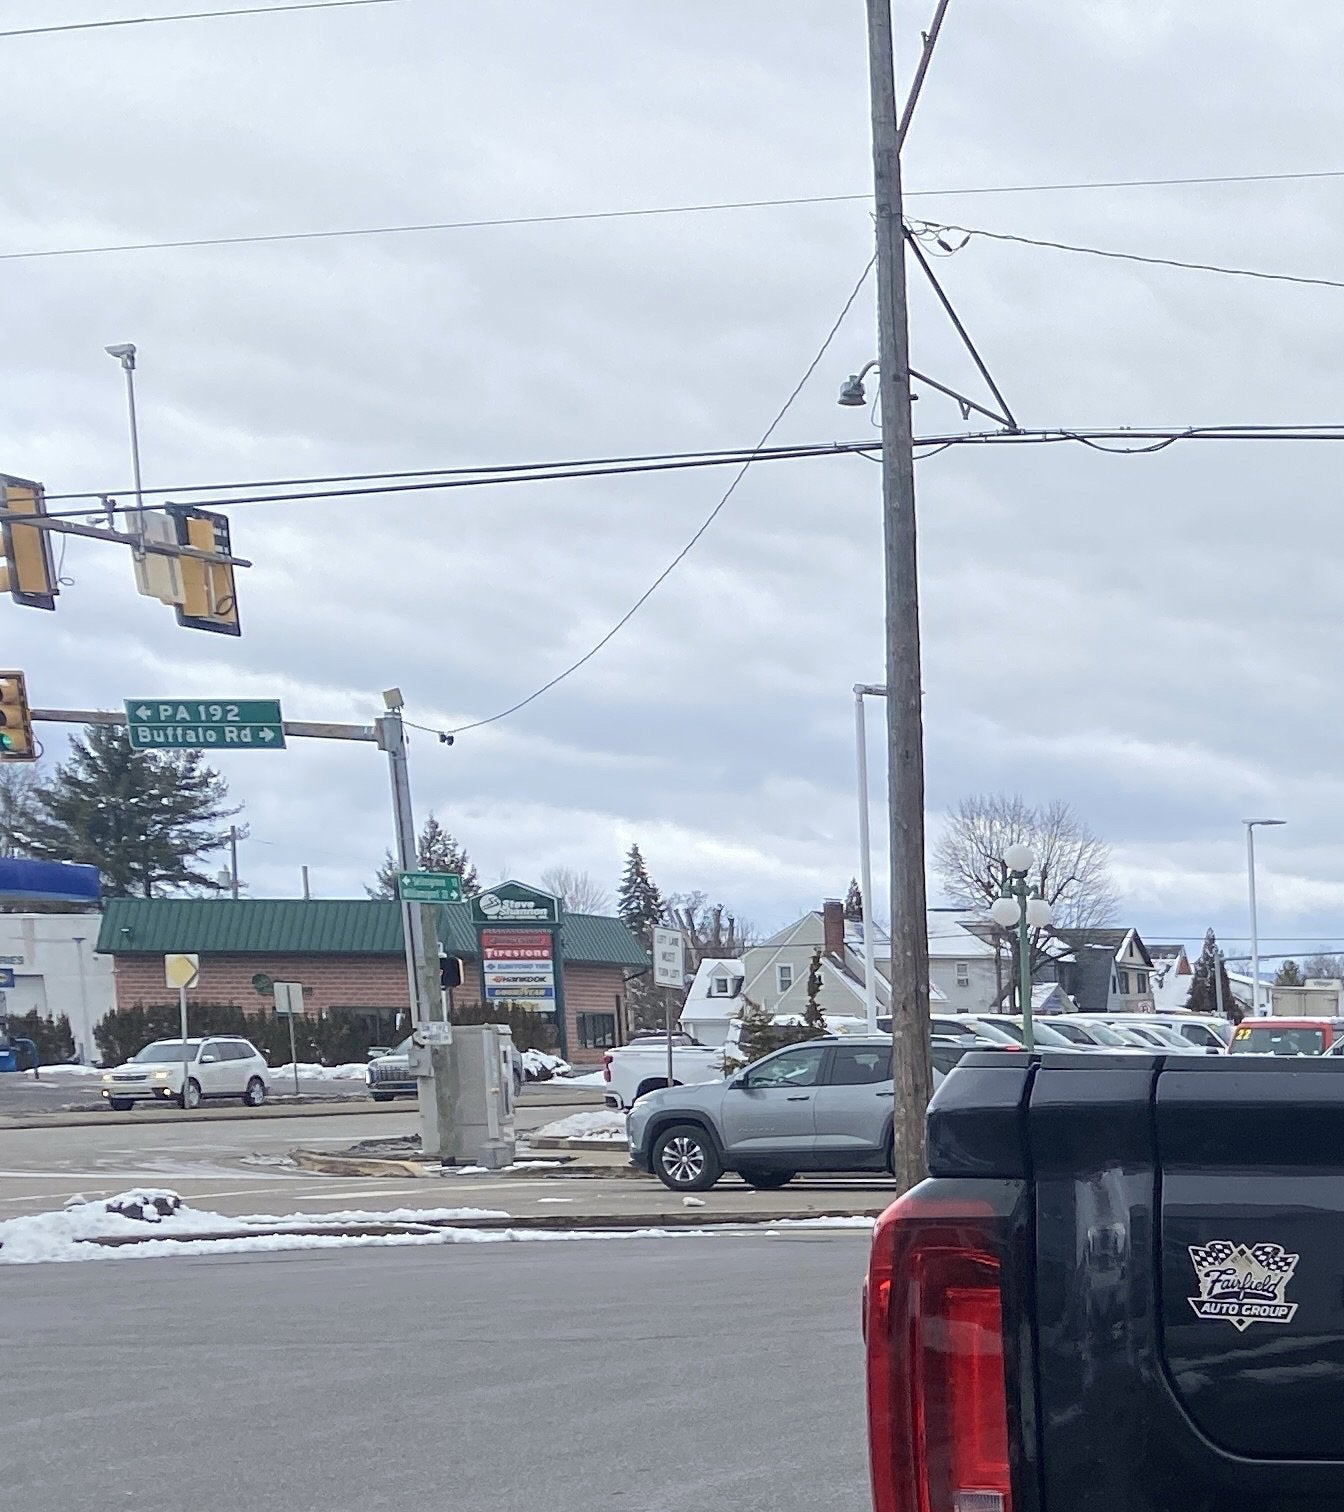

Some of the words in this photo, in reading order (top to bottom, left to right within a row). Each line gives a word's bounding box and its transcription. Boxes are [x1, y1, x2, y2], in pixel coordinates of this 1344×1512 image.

[159, 705, 190, 720] PA
[198, 705, 240, 720] 192
[137, 727, 217, 742] Buffalo
[224, 727, 252, 742] Rd
[500, 908, 548, 916] Shannon
[501, 900, 535, 909] Steve
[485, 948, 550, 958] Firestone
[1204, 1268, 1284, 1300] Fairfield
[1201, 1302, 1238, 1315] AUTO
[1241, 1304, 1288, 1317] GROUP
